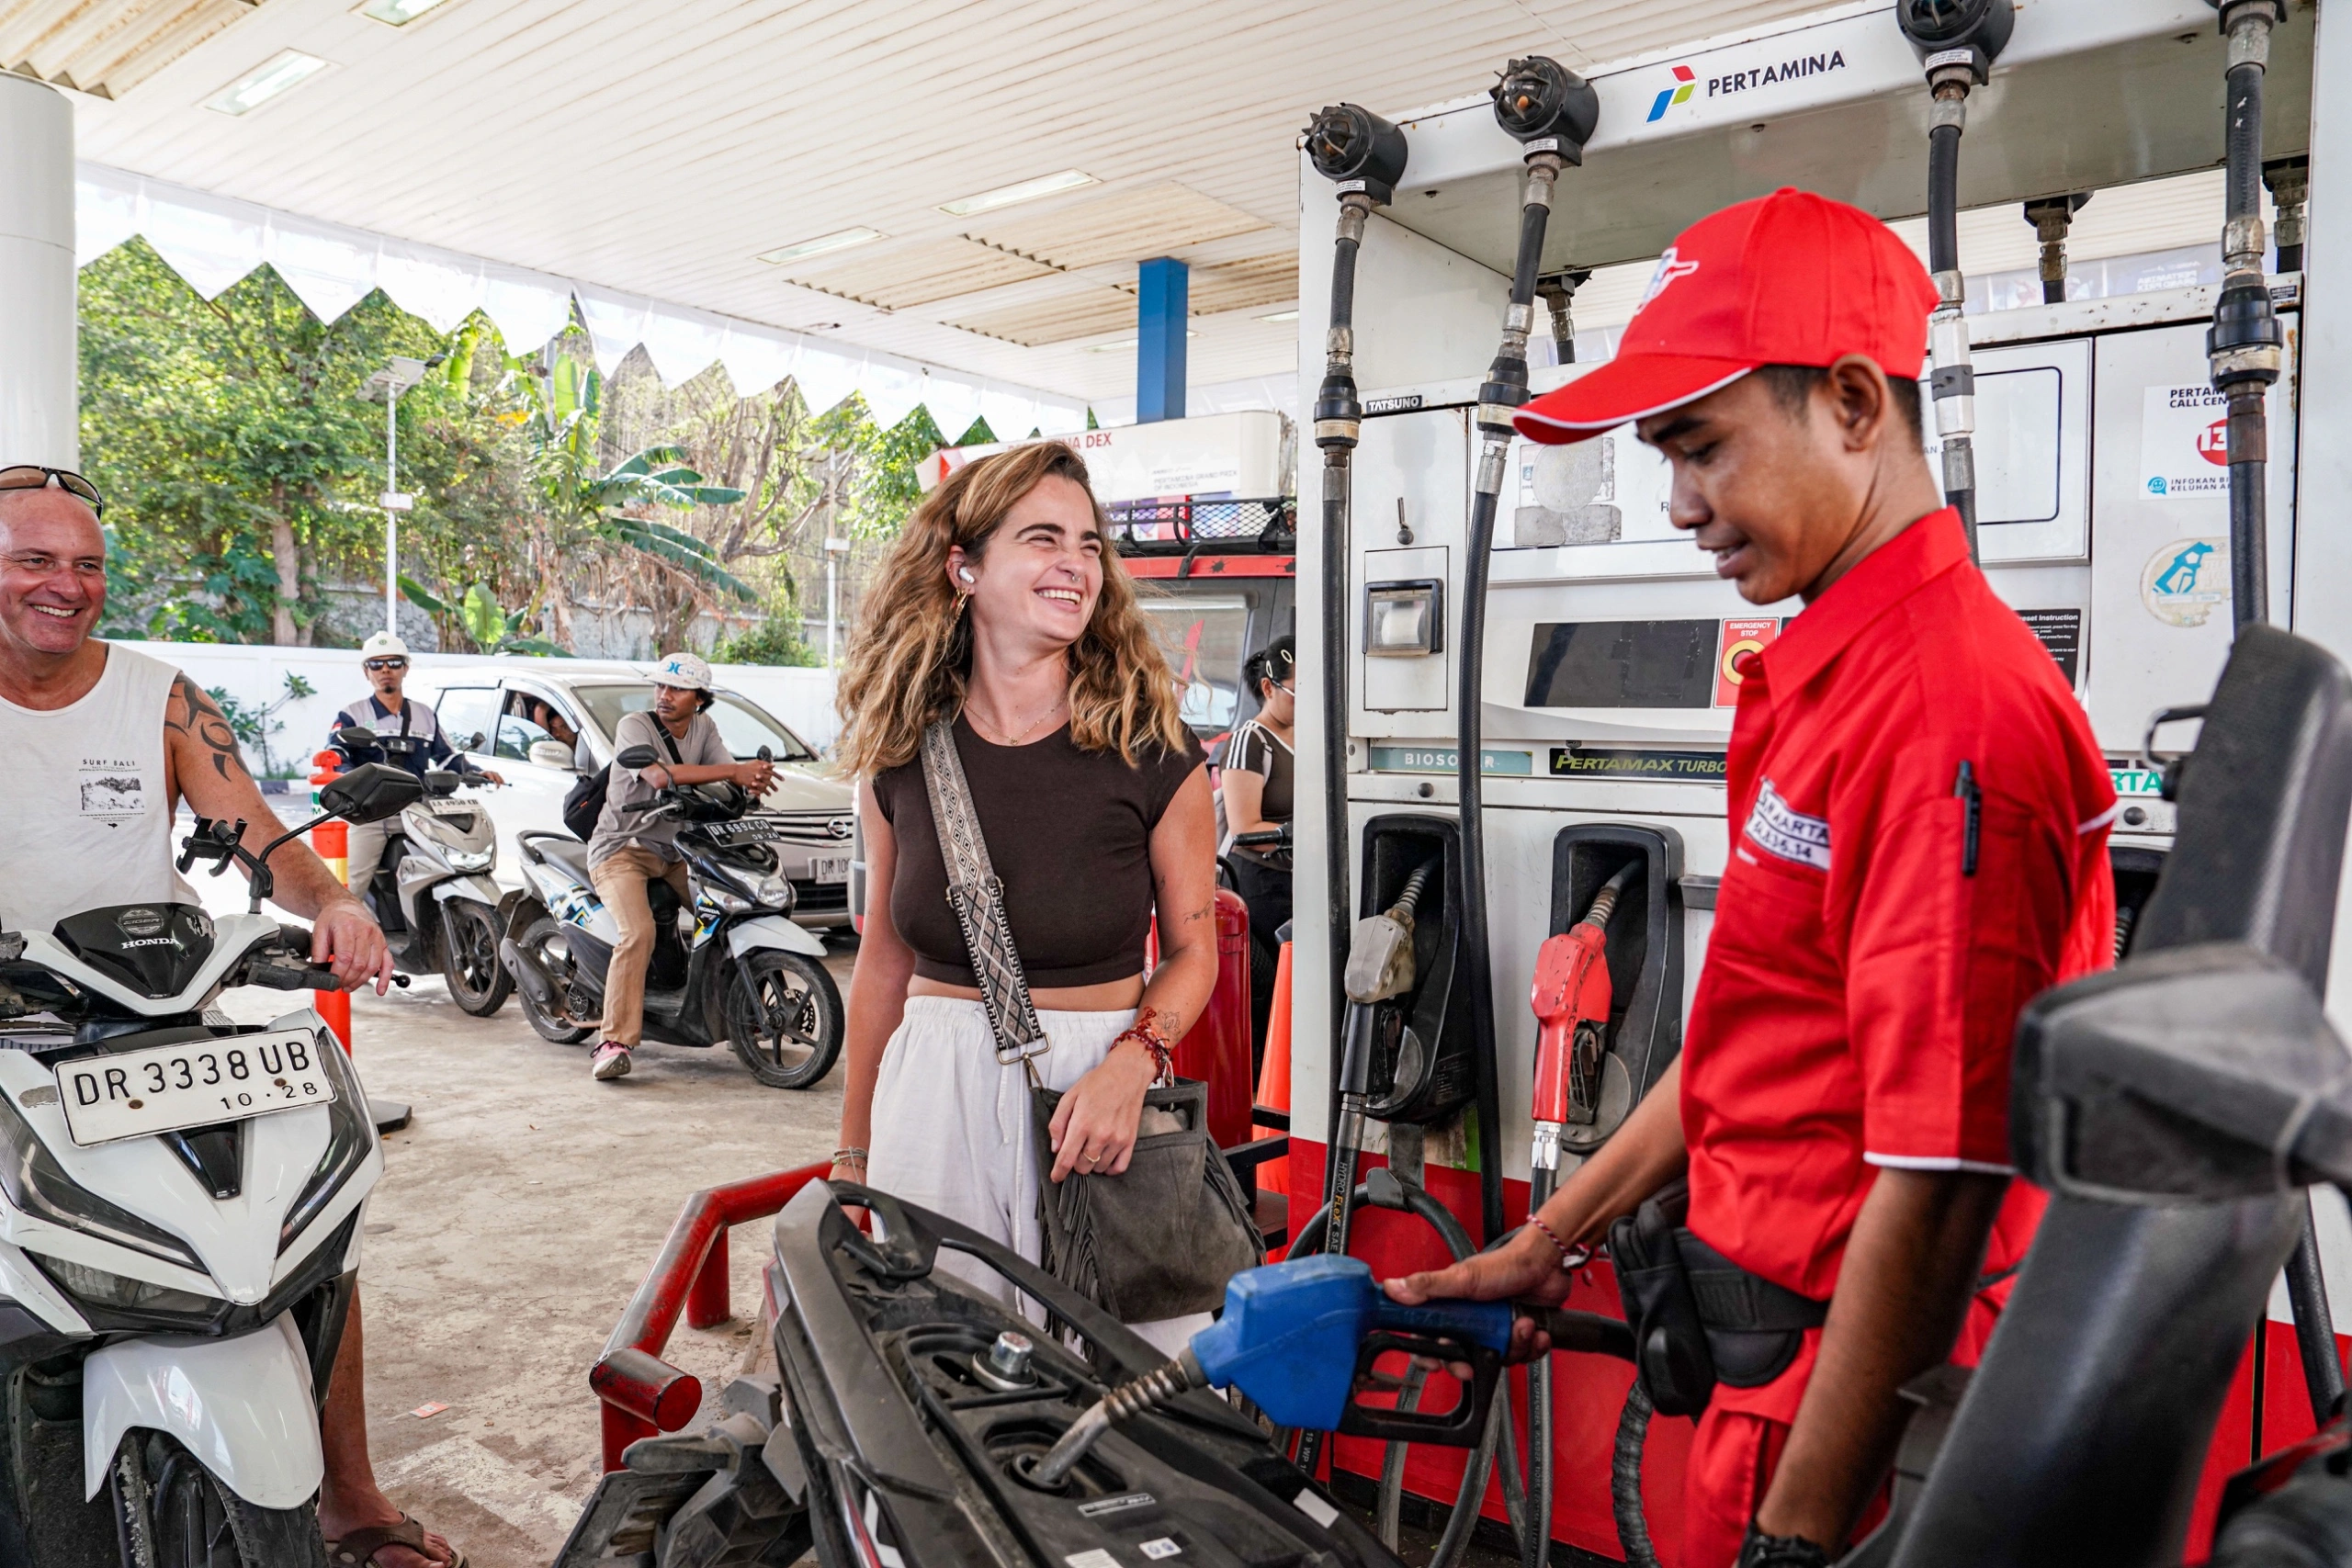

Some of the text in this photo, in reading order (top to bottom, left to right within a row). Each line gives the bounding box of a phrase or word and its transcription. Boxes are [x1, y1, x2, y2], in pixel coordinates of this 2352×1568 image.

[1709, 50, 1846, 97] PERTAMINA
[2170, 387, 2224, 399] PERTAM
[1369, 397, 1419, 412] TATSUNO
[2169, 397, 2227, 408] CALL CEN
[1086, 433, 1112, 448] DEX
[2199, 425, 2228, 451] 13
[1405, 752, 1495, 769] BIOSOR
[1555, 754, 1727, 773] PERTAMAX TURBO
[709, 825, 727, 836] DR
[726, 821, 755, 833] 6994
[821, 859, 834, 874] DR
[121, 937, 184, 950] HONDA
[74, 1041, 310, 1106] DR 3338 UB
[1336, 1161, 1348, 1193] HYDRO
[1330, 1231, 1340, 1250] SAE
[1302, 1447, 1311, 1462] WP
